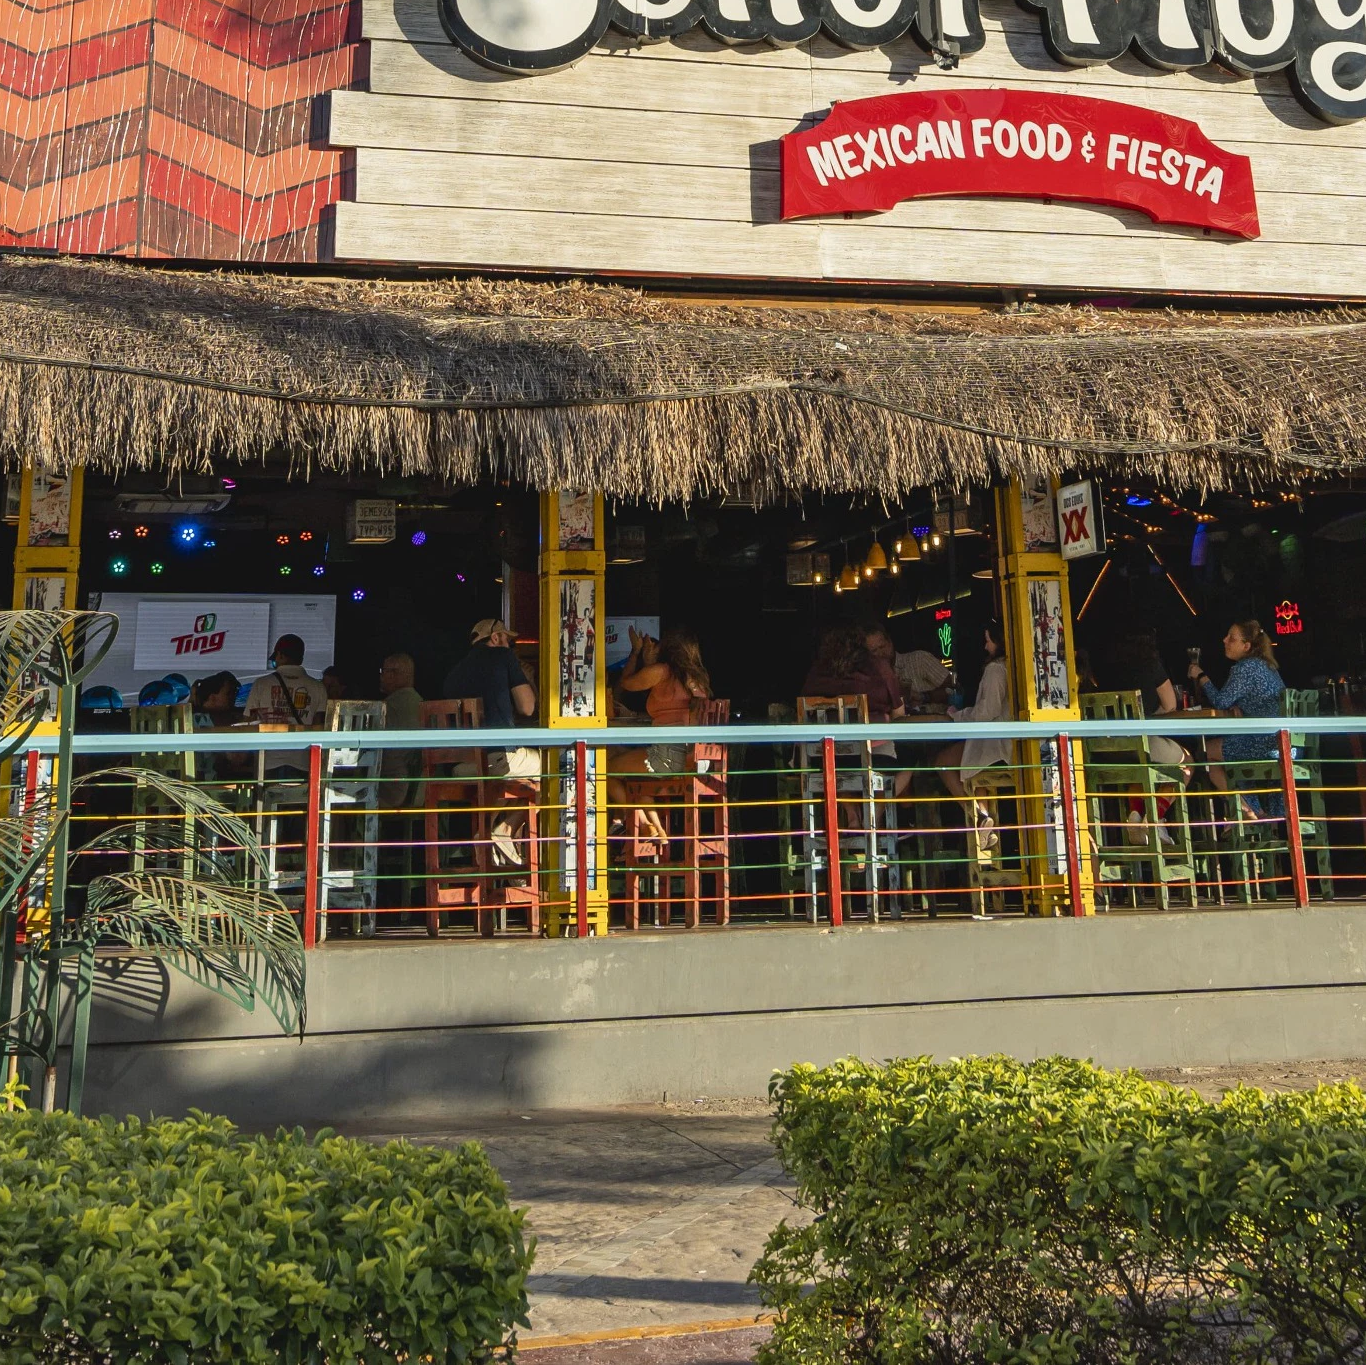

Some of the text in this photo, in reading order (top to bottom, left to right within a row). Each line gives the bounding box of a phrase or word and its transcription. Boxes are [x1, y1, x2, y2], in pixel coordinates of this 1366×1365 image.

[806, 117, 1226, 205] MEXICAN FOOD & FIESTA
[1060, 505, 1090, 546] XX
[170, 630, 227, 655] Ting
